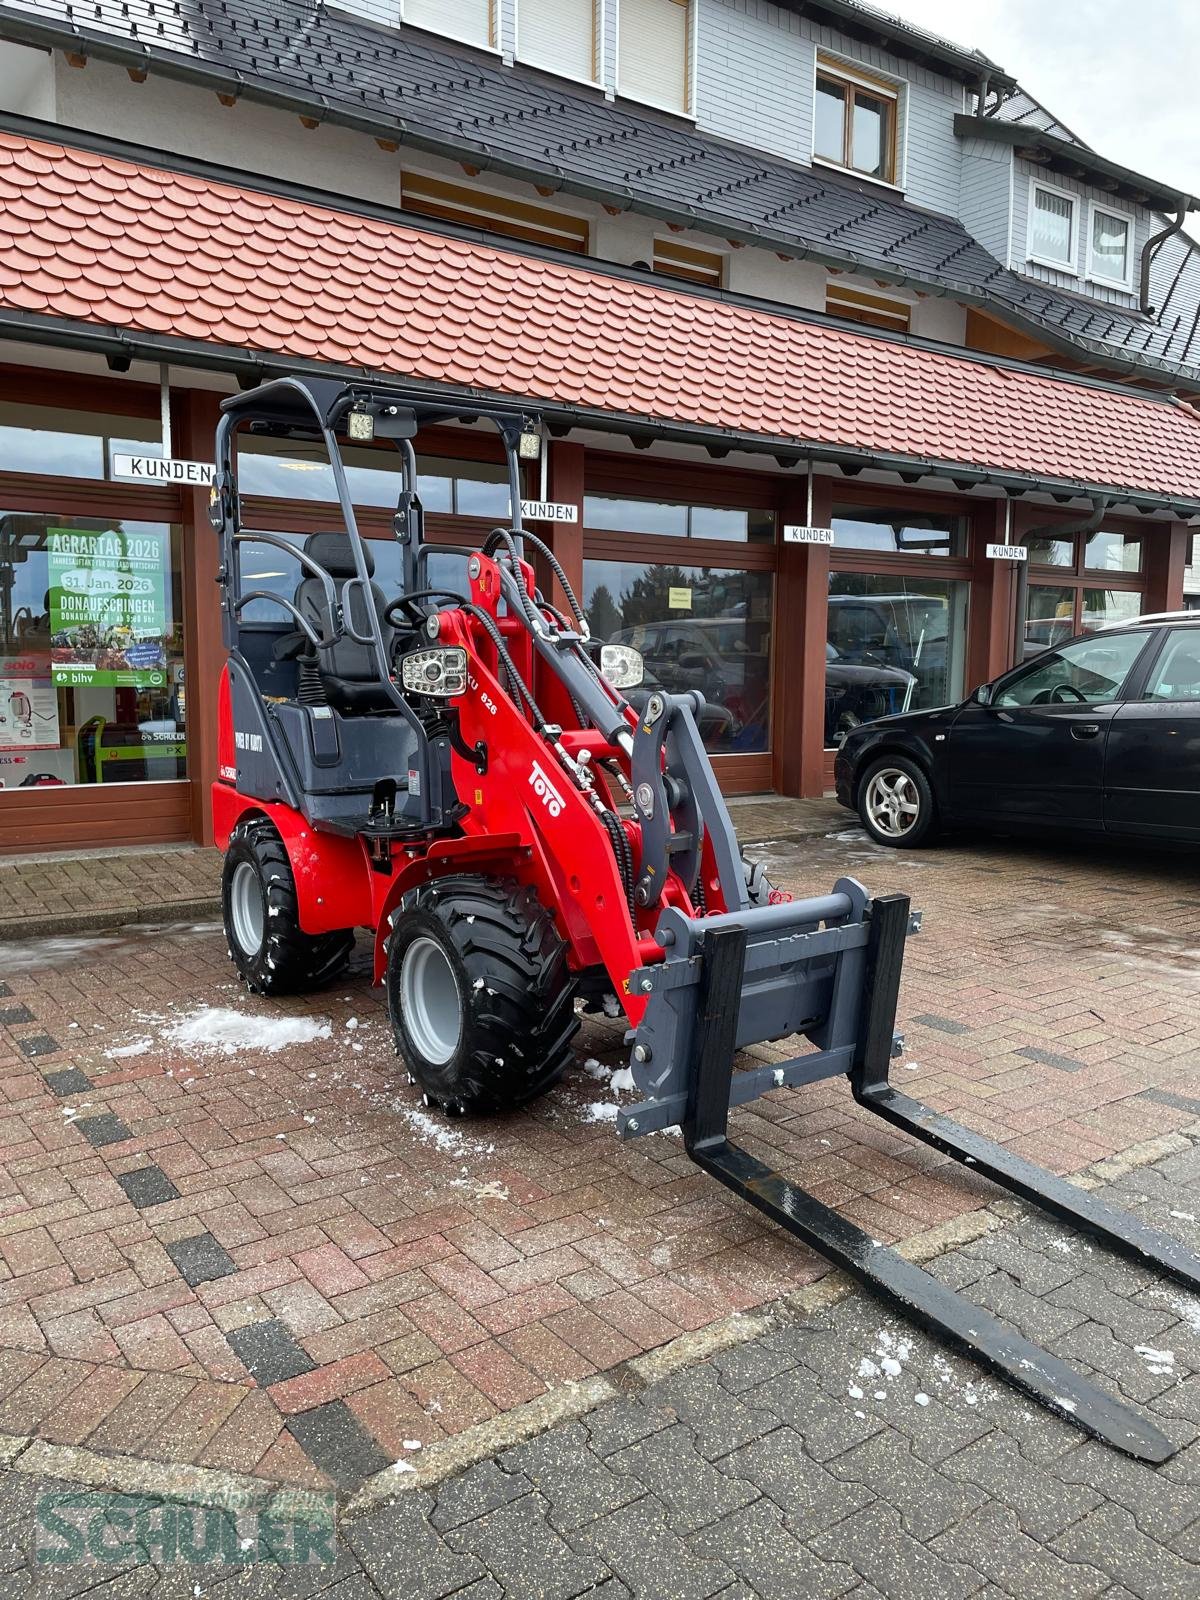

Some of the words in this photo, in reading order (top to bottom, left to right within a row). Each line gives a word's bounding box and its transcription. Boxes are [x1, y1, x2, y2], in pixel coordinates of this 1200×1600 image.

[131, 458, 211, 482] KUNDEN
[520, 502, 573, 520] KUNDEN
[792, 528, 831, 542] KUNDEN
[52, 533, 123, 556] AGRARTAG
[126, 539, 160, 558] 2026
[992, 546, 1024, 558] KUNDEN
[65, 576, 85, 588] 31.
[87, 577, 114, 589] Jan.
[117, 579, 149, 591] 2026
[60, 596, 155, 613] DONAUESCHINGEN
[61, 612, 109, 622] DONAUHALLEN
[71, 673, 93, 684] blhv
[480, 692, 498, 716] 826
[528, 760, 567, 818] TOYO
